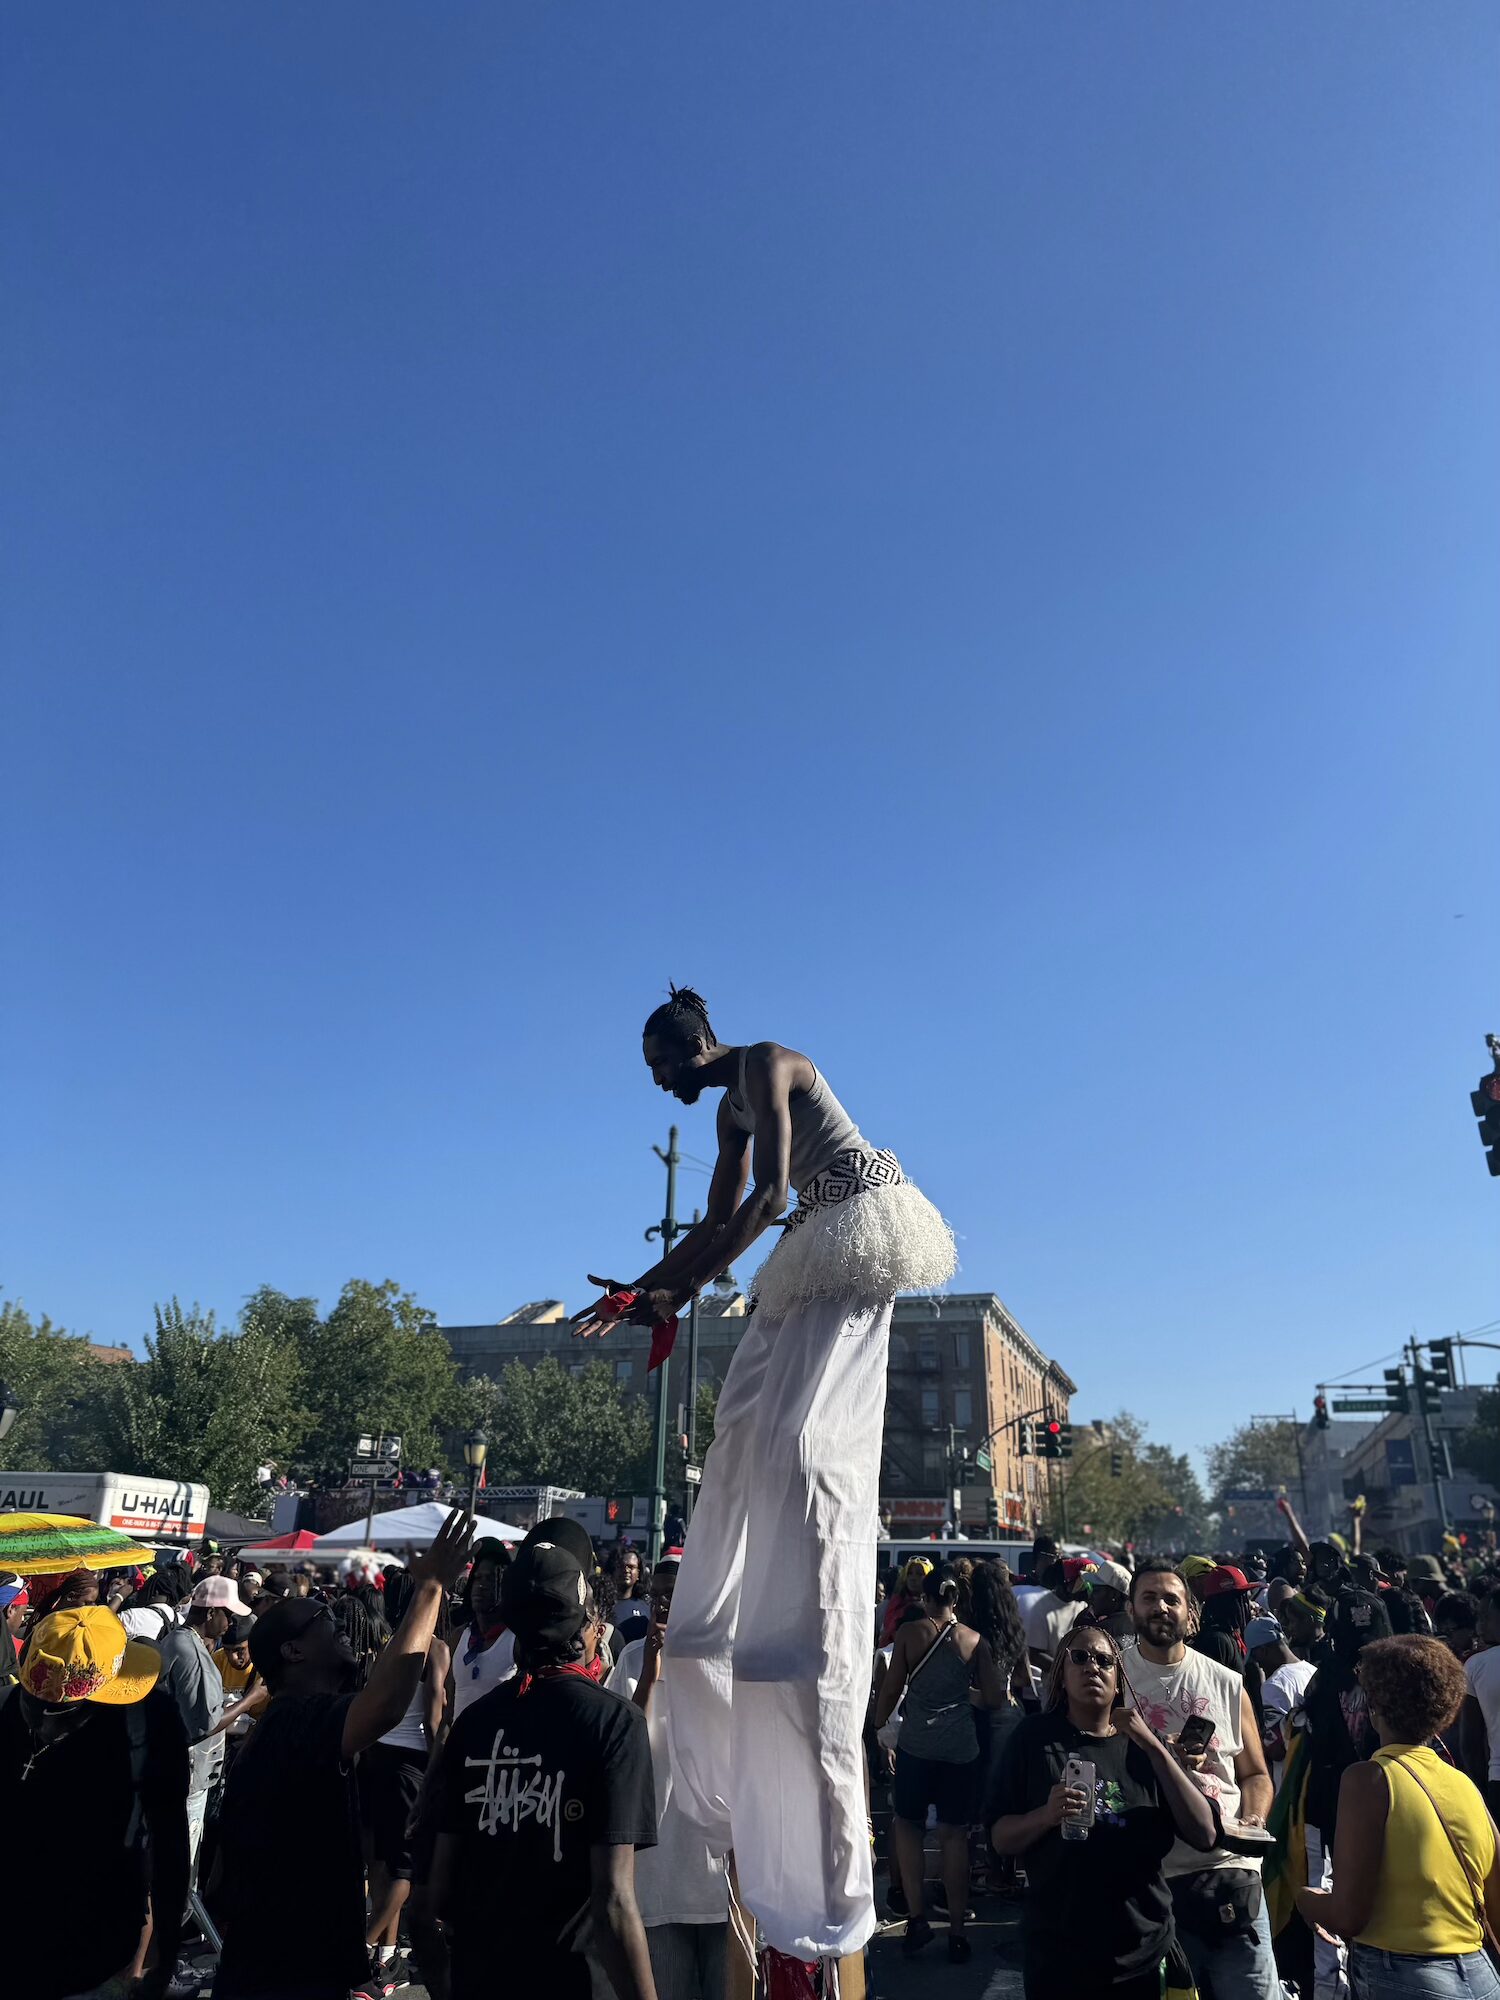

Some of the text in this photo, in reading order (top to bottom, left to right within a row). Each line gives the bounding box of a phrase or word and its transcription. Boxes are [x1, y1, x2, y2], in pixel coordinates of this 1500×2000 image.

[354, 1465, 392, 1474] ONE WAY
[0, 1490, 49, 1509] AUL
[121, 1493, 194, 1518] U-HAUL
